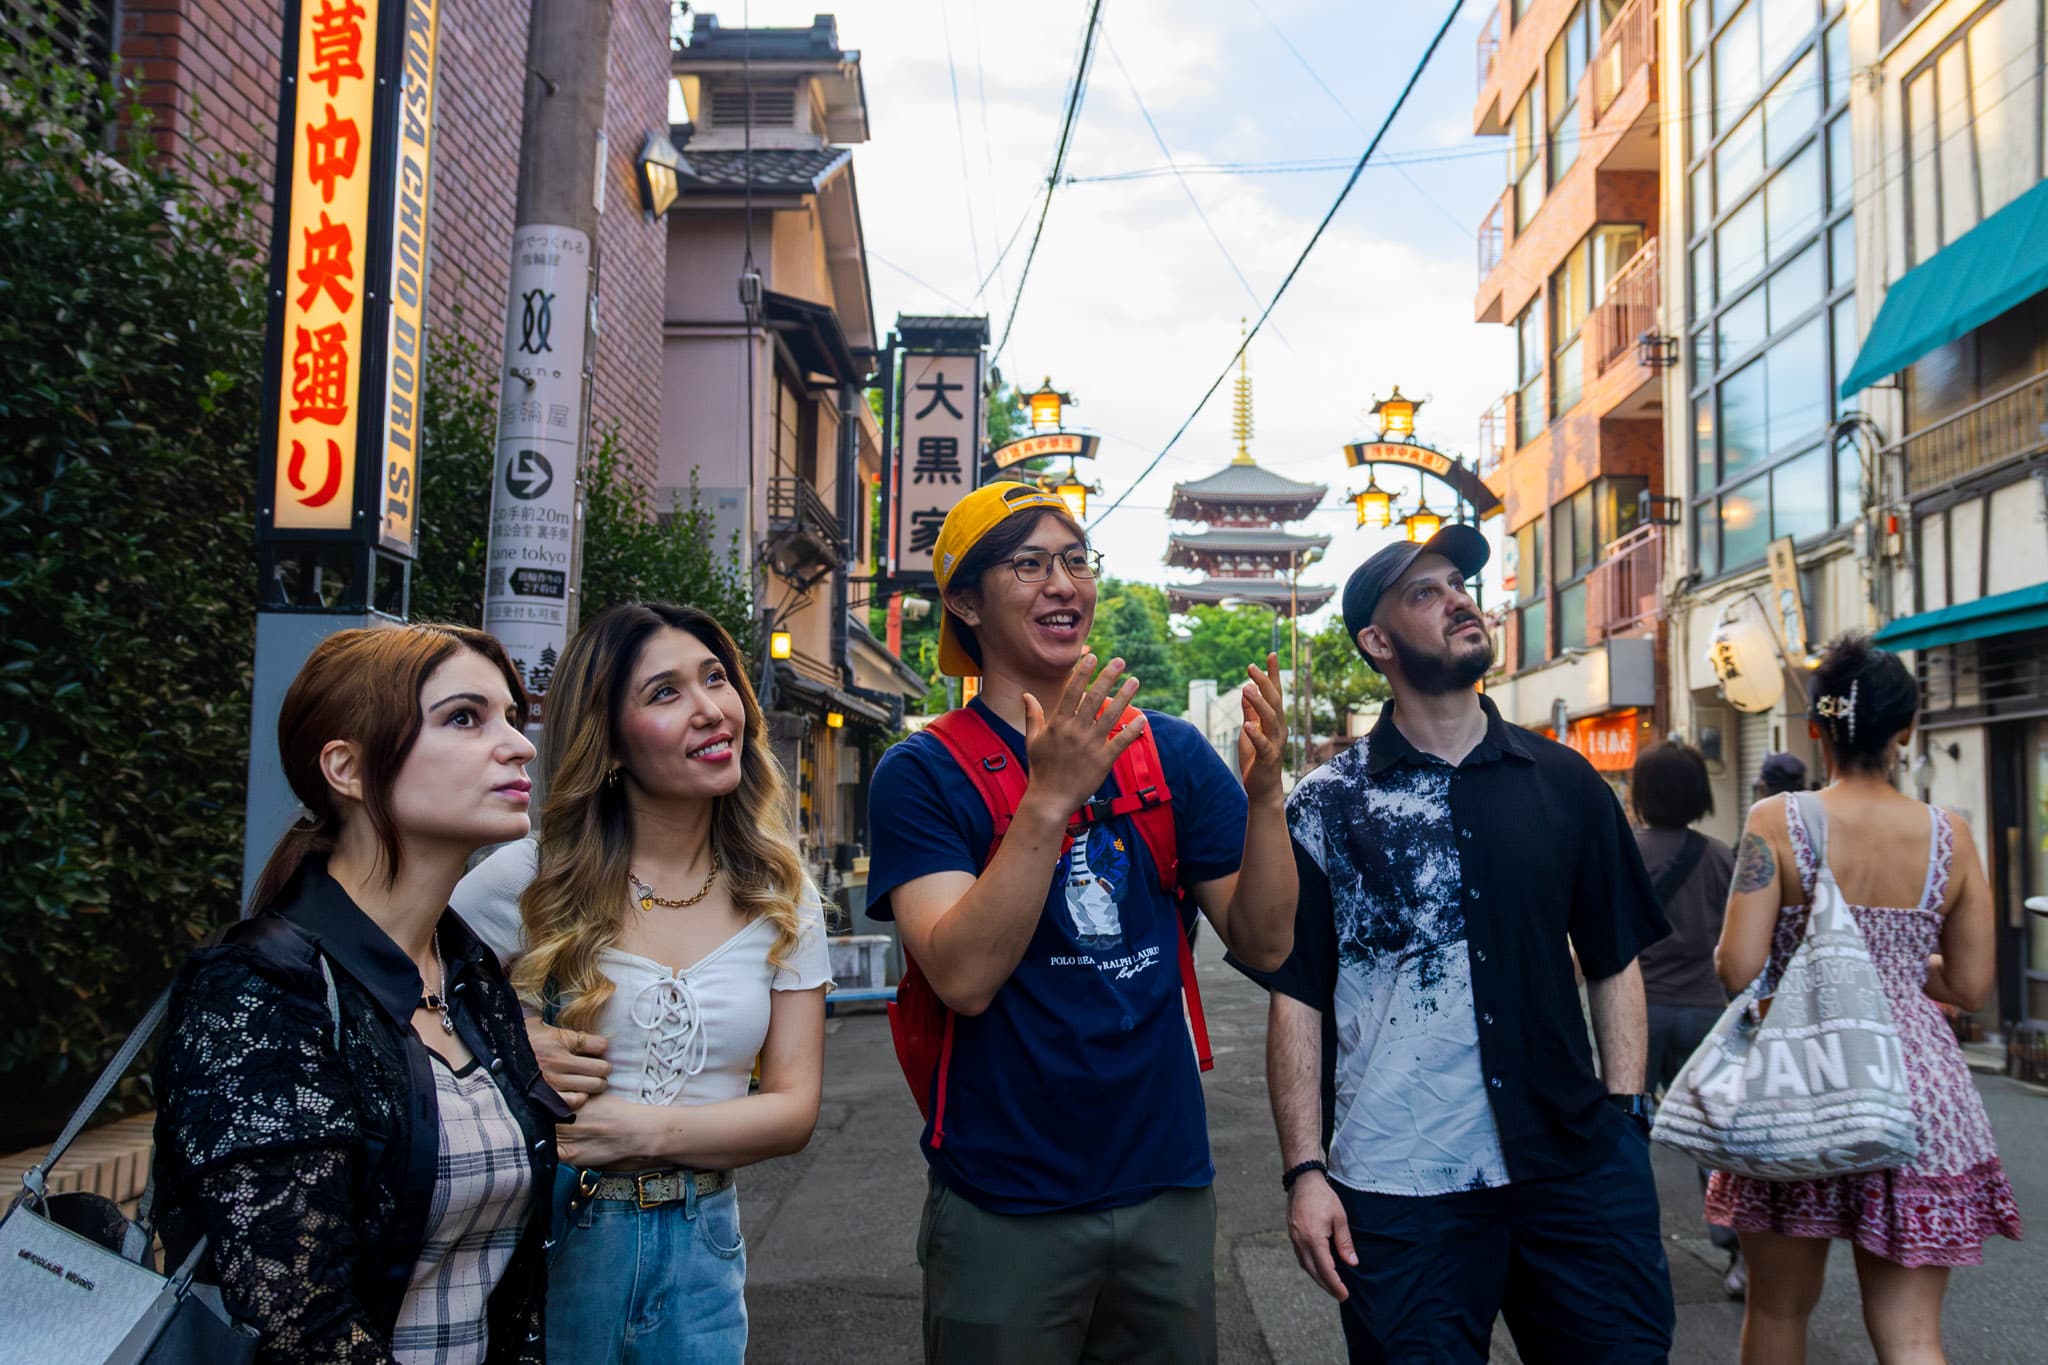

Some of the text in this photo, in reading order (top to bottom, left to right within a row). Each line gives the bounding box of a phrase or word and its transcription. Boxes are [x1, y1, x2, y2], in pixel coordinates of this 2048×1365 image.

[287, 0, 366, 508] 草中央通り
[386, 0, 434, 530] KUSA CHUO DORI St.
[522, 545, 567, 566] tokyo
[1050, 956, 1075, 966] POLO
[1077, 955, 1096, 965] BEA
[1102, 956, 1133, 970] RALPH
